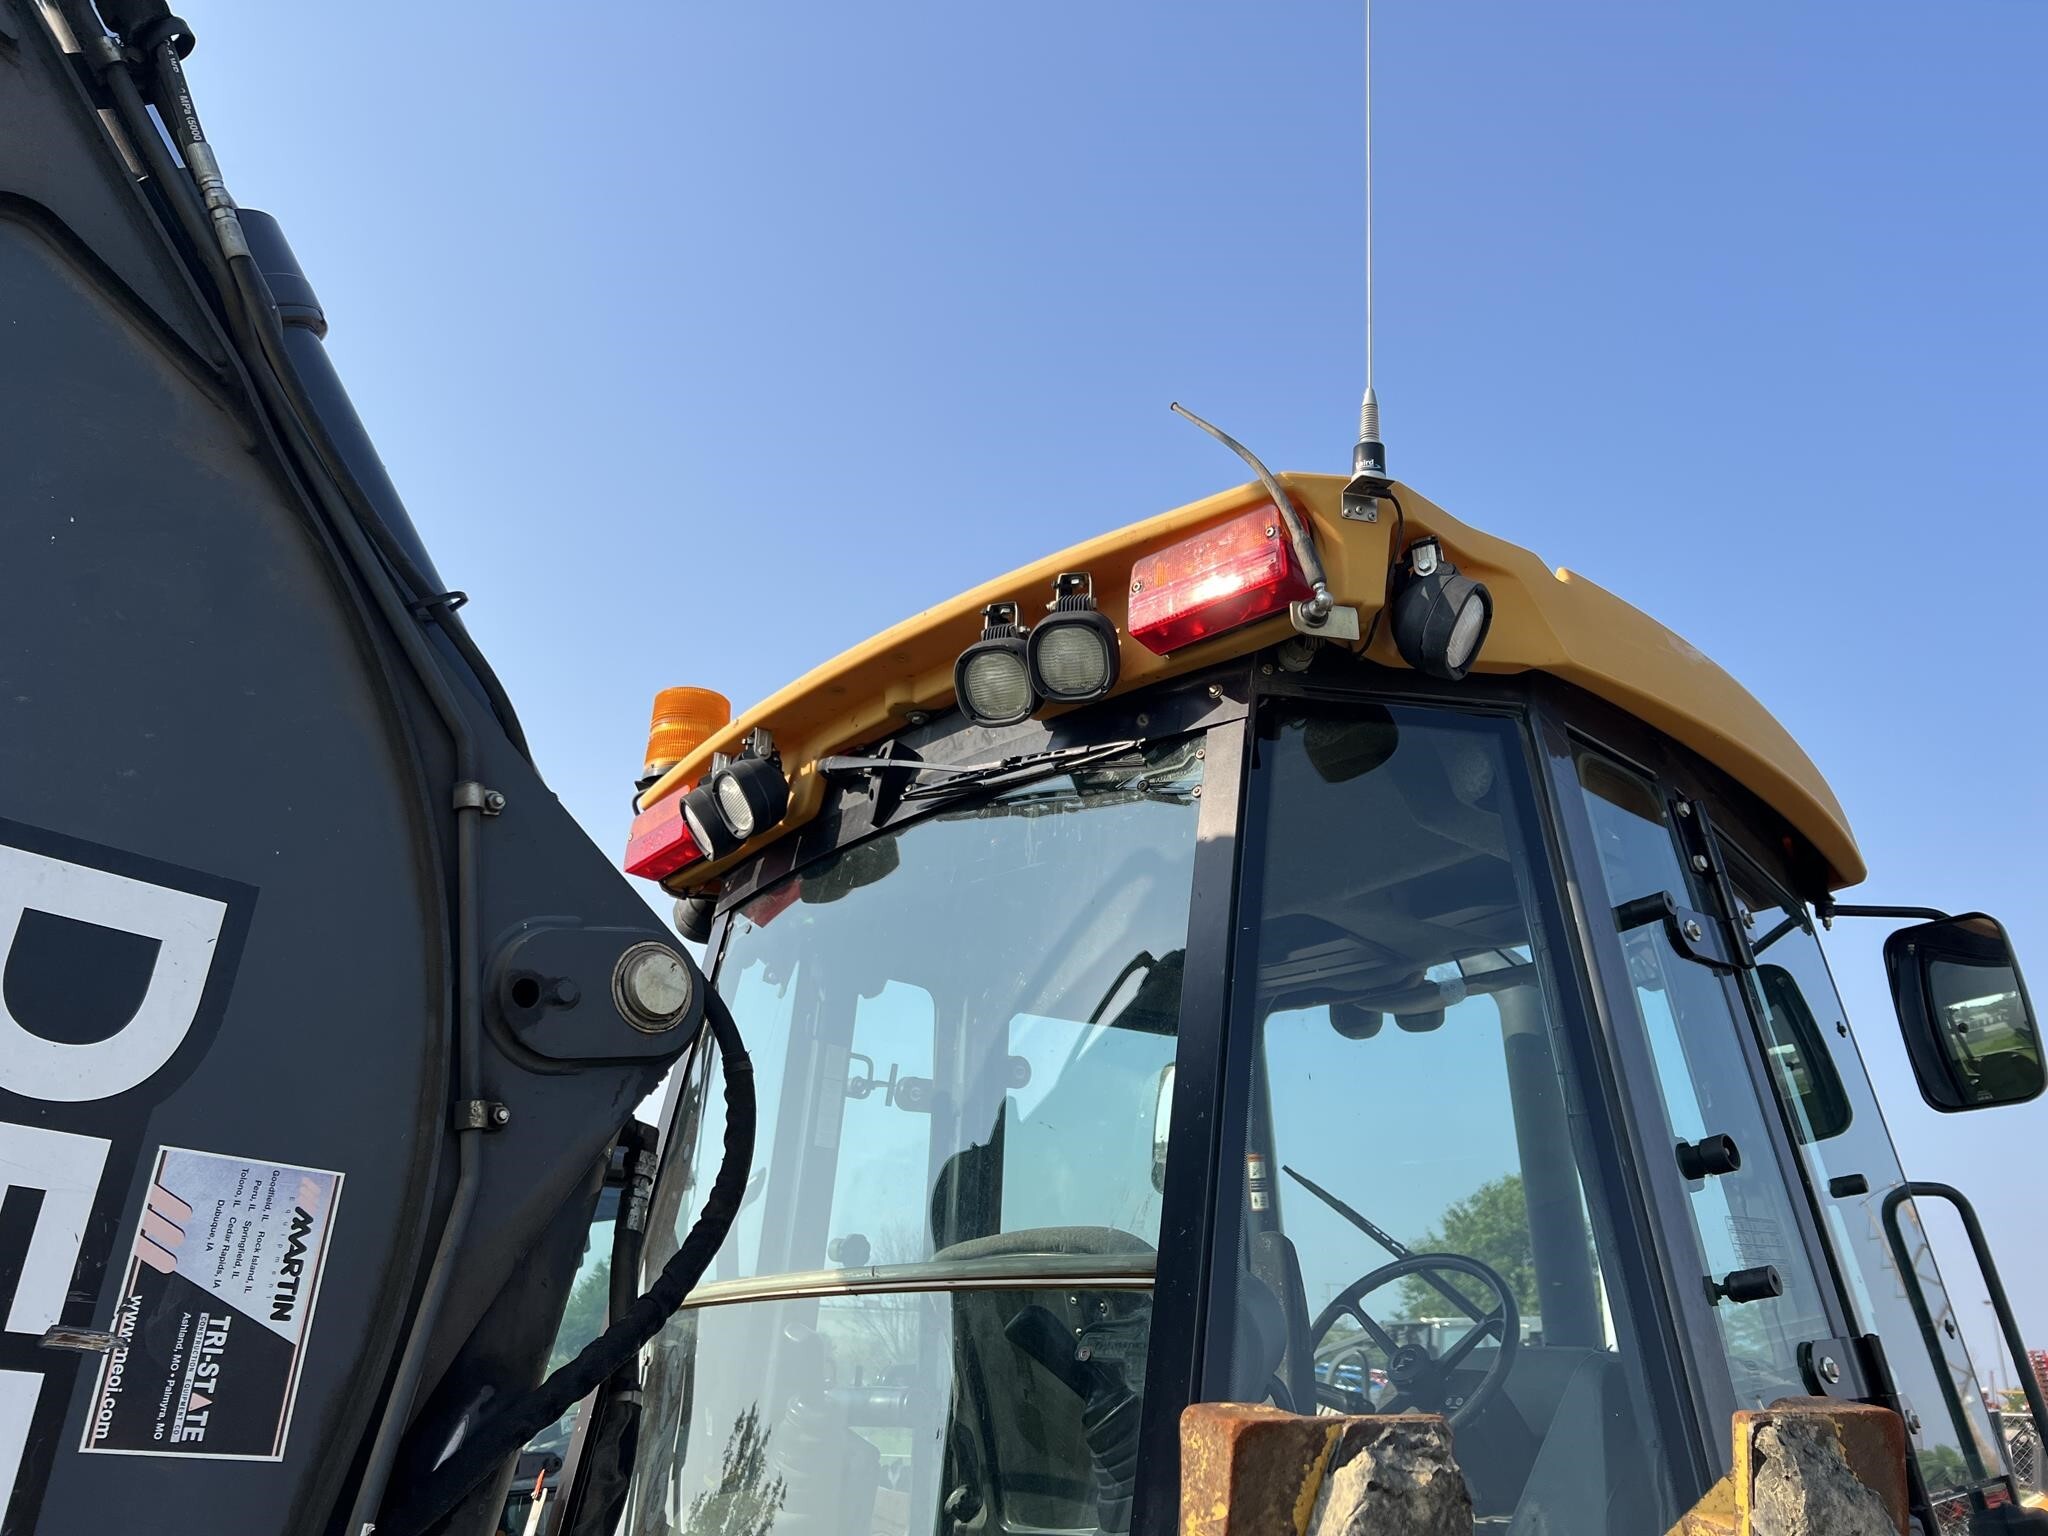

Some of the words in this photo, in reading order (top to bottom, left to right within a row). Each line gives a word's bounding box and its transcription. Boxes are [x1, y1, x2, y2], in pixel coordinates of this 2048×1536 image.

[180, 96, 191, 115] MPa
[233, 1167, 249, 1197] Tolono,
[248, 1179, 262, 1201] Peru,
[262, 1169, 280, 1212] Goodfield,
[232, 1199, 241, 1208] IL
[247, 1203, 256, 1211] IL
[206, 1198, 225, 1240] Dubuque,
[224, 1216, 237, 1243] Cedar
[260, 1213, 269, 1222] IL
[204, 1241, 214, 1251] IA
[232, 1219, 252, 1268] Springfield,
[253, 1230, 265, 1252] Rock
[213, 1244, 230, 1277] Rapids,
[244, 1254, 260, 1283] Island,
[269, 1205, 314, 1321] MARTIN
[212, 1278, 222, 1288] IA
[231, 1270, 240, 1279] IL
[243, 1285, 252, 1293] IL
[172, 1311, 191, 1352] Ashland,
[187, 1315, 207, 1372] CONSTRUCTION
[169, 1353, 181, 1371] MO
[180, 1315, 231, 1441] TRI-STATE
[156, 1379, 175, 1420] Palmyra,
[176, 1378, 192, 1420] EQUIPMENT
[153, 1422, 165, 1440] MO
